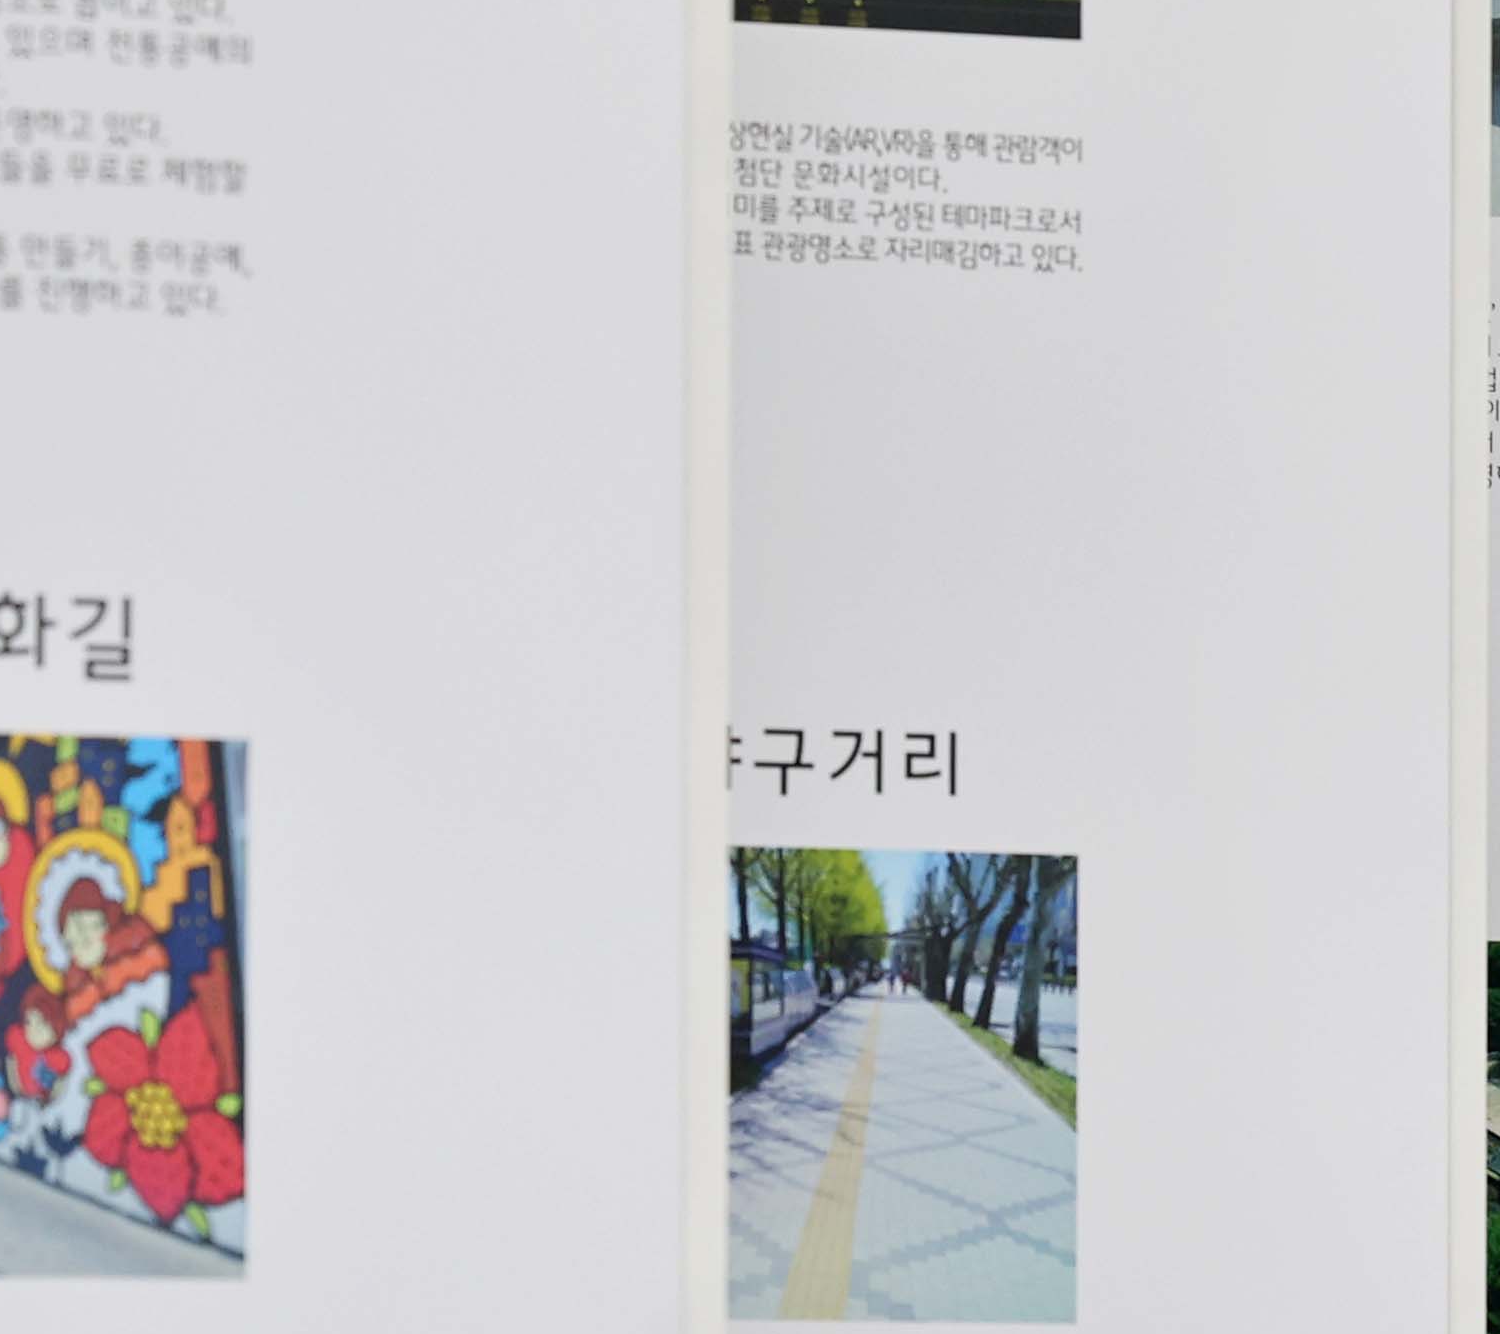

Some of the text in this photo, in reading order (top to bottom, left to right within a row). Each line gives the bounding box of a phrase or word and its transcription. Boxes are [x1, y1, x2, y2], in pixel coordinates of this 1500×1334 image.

[942, 130, 989, 163] 통해
[992, 133, 1084, 166] 관람객이
[792, 159, 949, 195] 문화시설이다.
[787, 195, 858, 225] 주제로
[864, 199, 936, 233] 구성된
[940, 202, 1082, 235] 테마파크로서
[760, 230, 879, 265] 관광명소로
[883, 236, 1026, 271] 자리매김하고
[1030, 242, 1084, 274] 있다.
